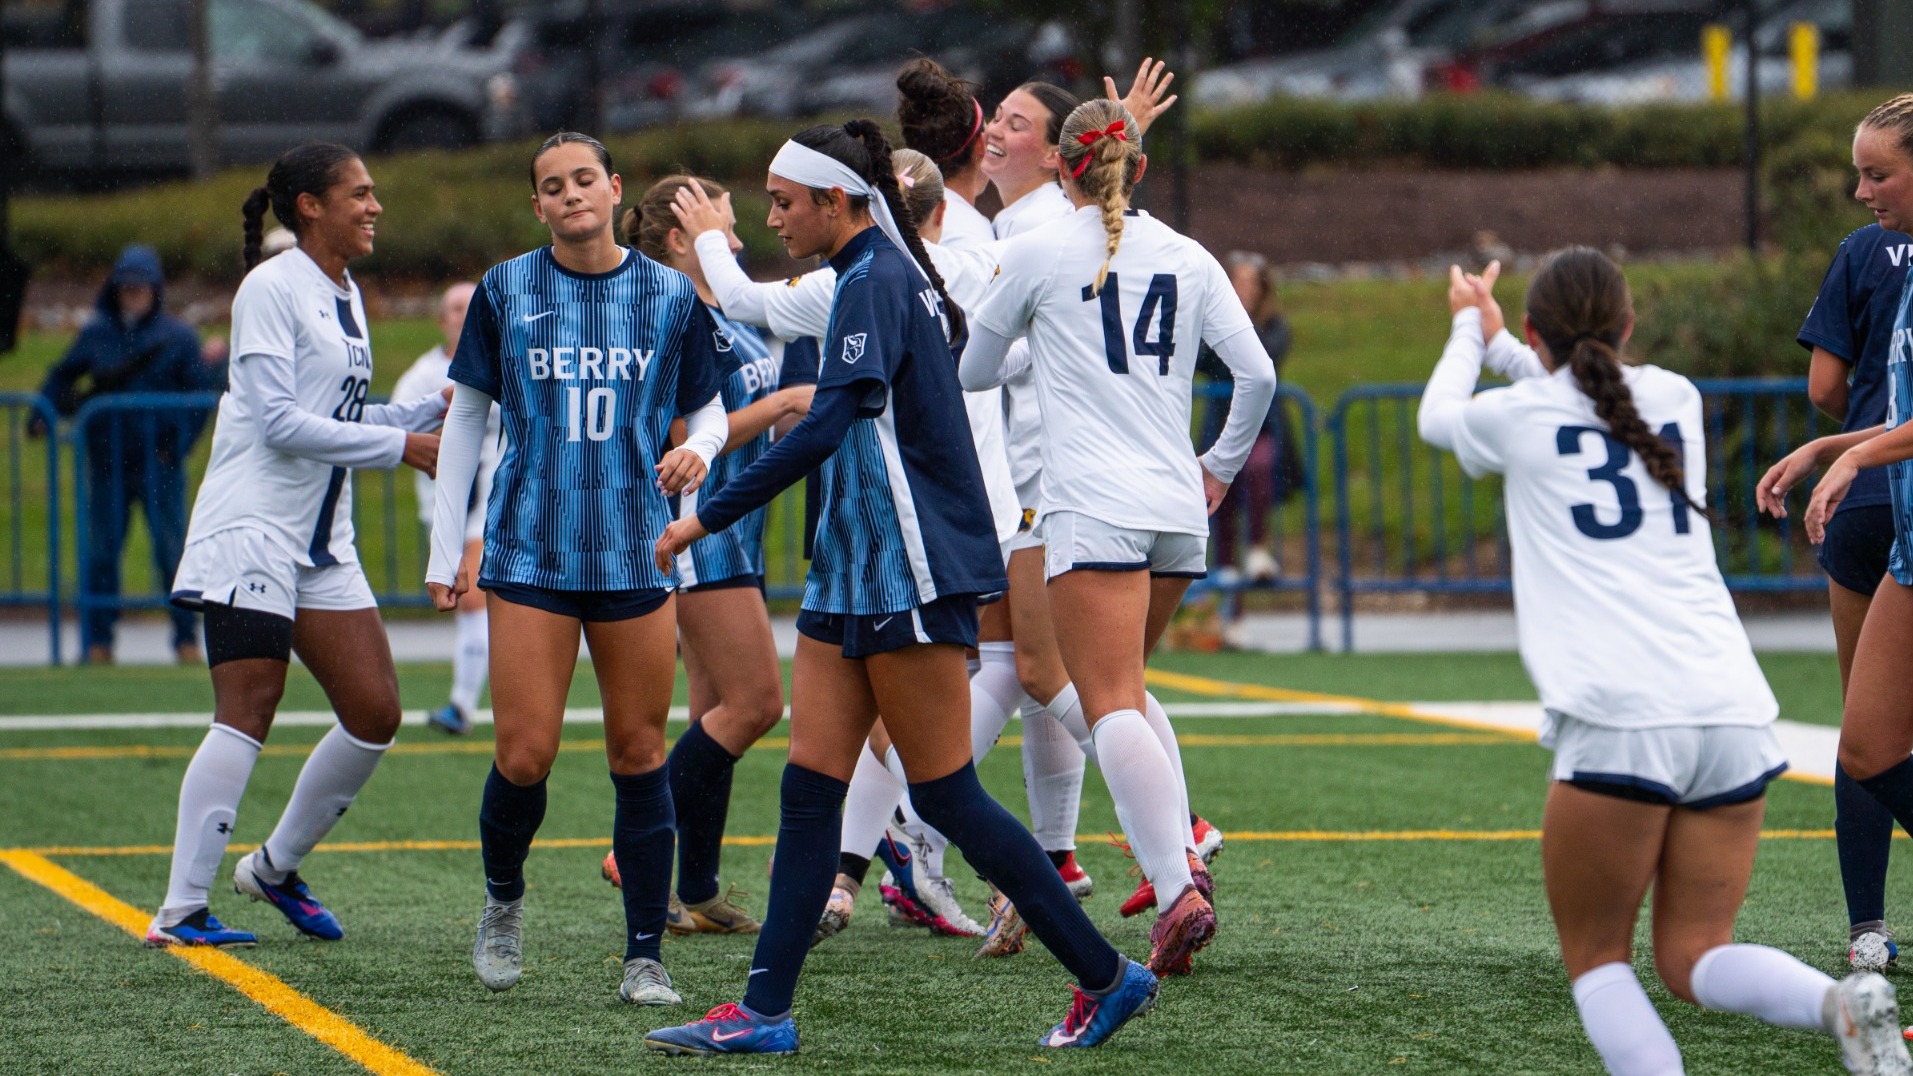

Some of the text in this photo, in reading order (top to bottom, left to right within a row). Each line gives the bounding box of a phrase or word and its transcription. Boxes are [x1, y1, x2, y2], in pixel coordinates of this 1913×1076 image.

[1081, 271, 1178, 376] 14
[528, 347, 656, 381] BERRY
[332, 375, 370, 424] 28
[567, 387, 617, 442] 10
[1556, 421, 1692, 540] 31
